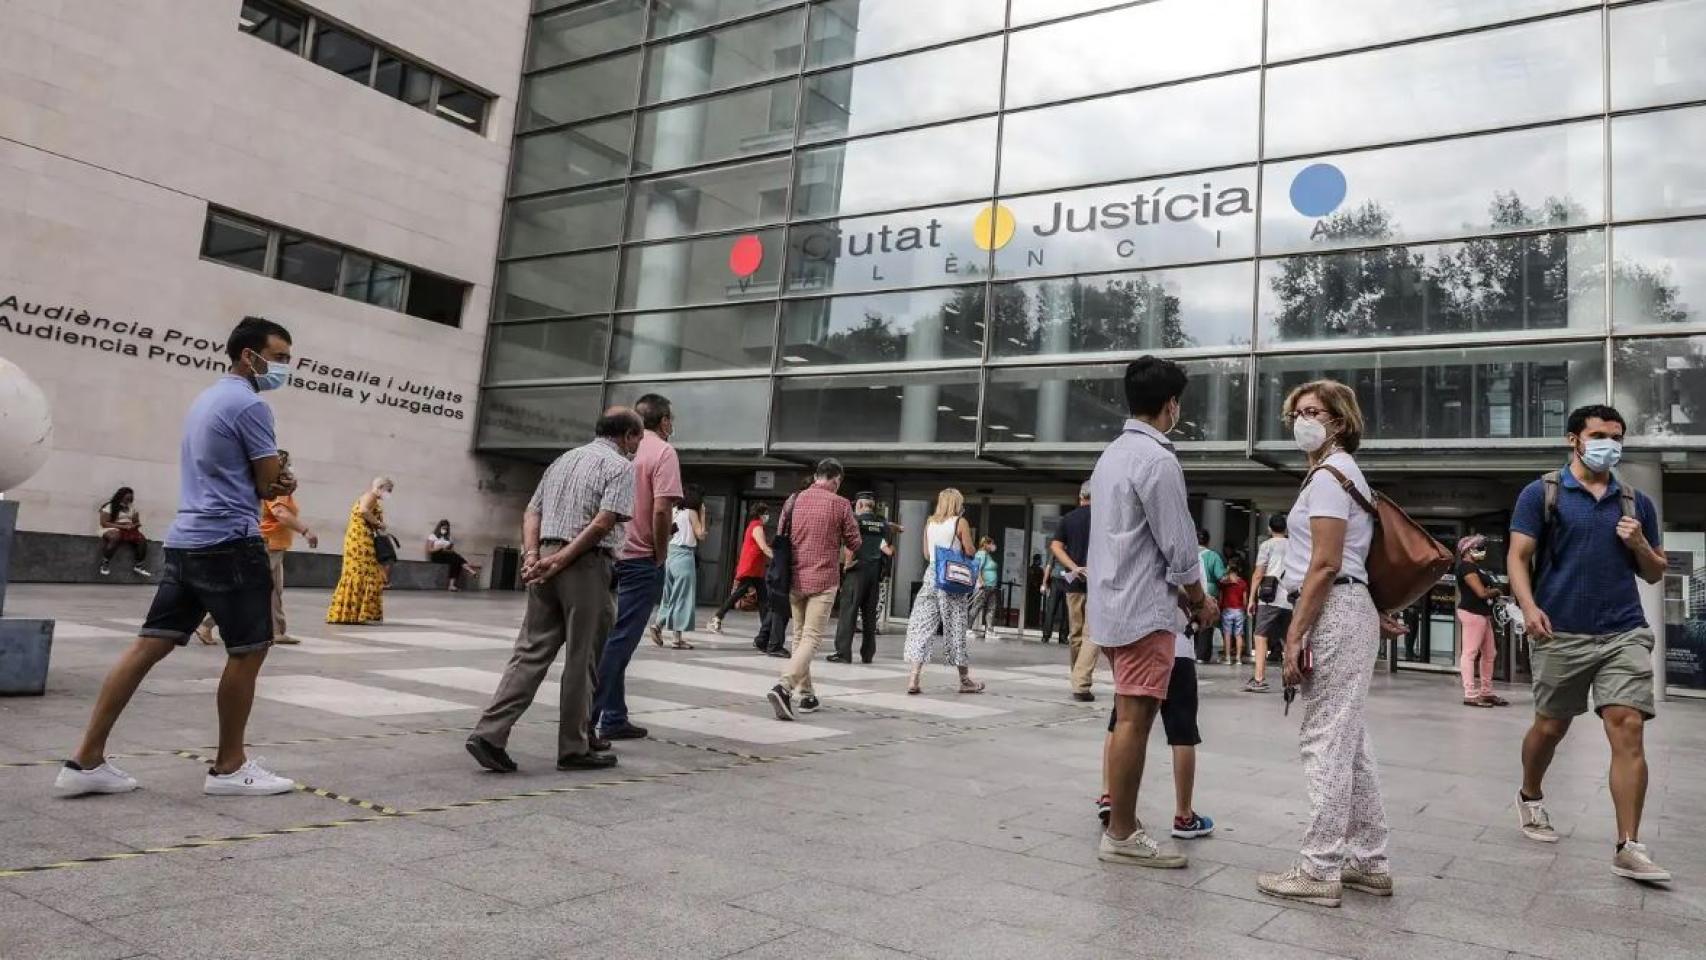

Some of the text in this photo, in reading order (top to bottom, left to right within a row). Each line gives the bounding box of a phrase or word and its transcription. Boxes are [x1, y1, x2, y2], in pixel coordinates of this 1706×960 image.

[803, 183, 1253, 261] Ciutat Justícia
[0, 296, 463, 404] Audiència Prov Fiscalia i Jutjats
[0, 315, 464, 420] Audiencia Provin iscalía y Juzgados
